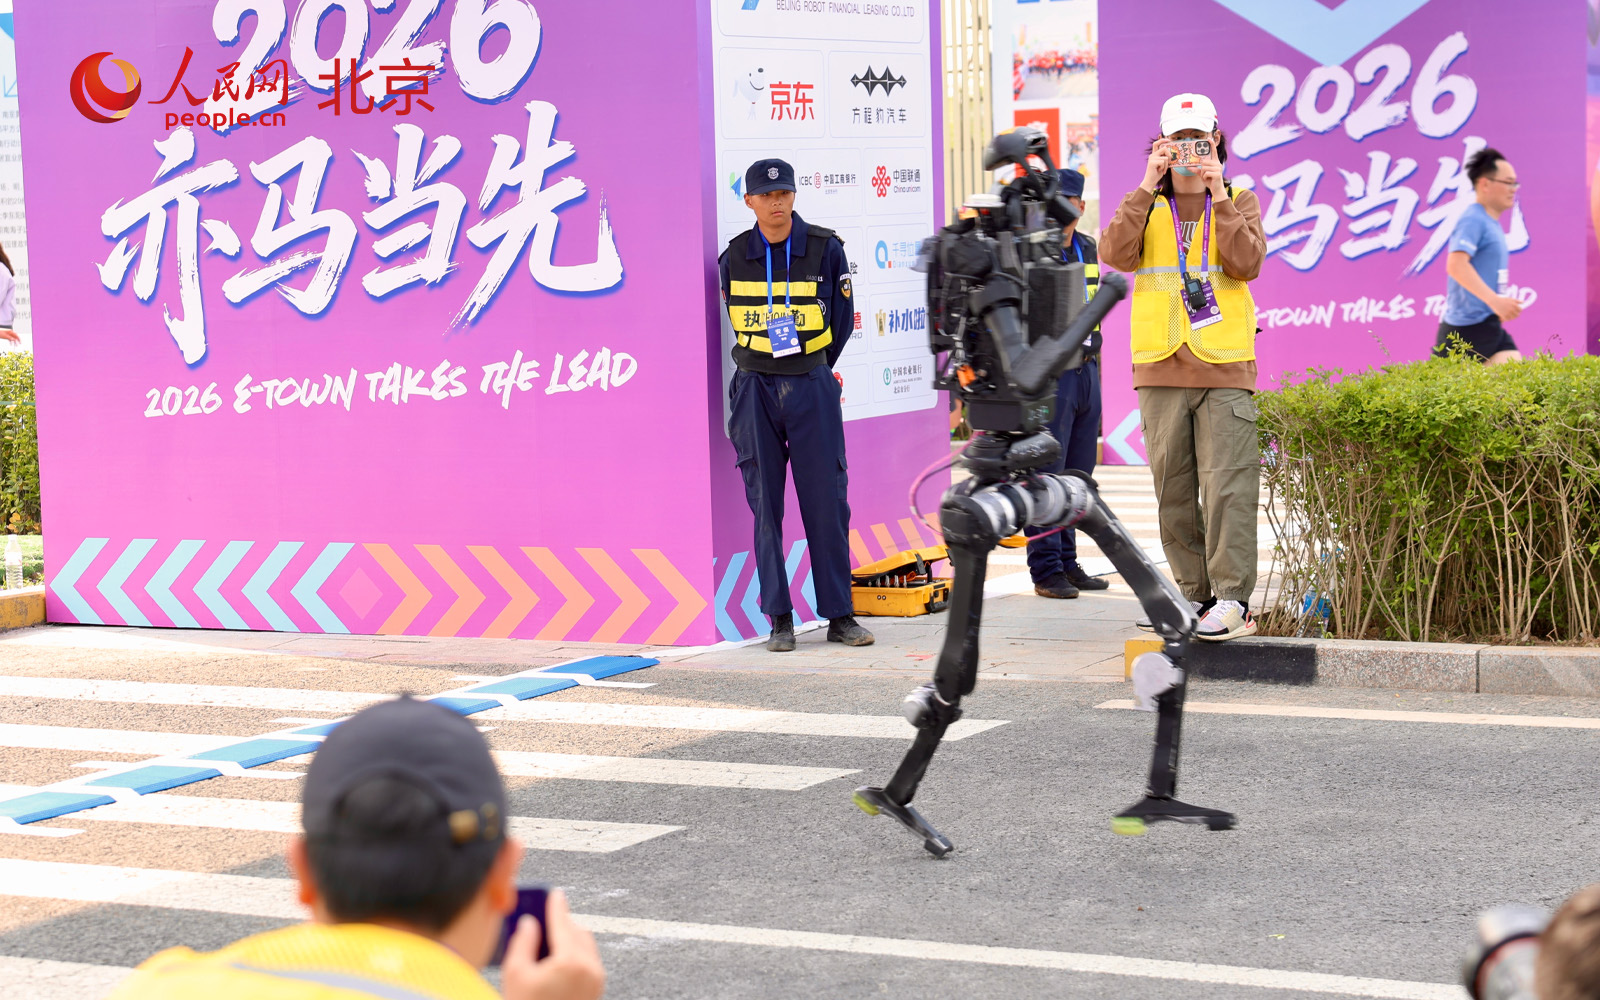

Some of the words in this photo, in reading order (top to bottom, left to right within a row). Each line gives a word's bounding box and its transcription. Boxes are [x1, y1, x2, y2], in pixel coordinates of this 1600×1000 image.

[776, 0, 801, 11] BEIJING
[804, 1, 826, 13] ROBOT
[829, 2, 861, 15] FINANCIAL
[864, 4, 889, 16] LEASING
[205, 0, 542, 131] 2026
[769, 81, 815, 121] 京东
[1231, 31, 1478, 159] 2026
[852, 107, 907, 124] 方程豹汽车
[798, 176, 813, 186] ICBC
[892, 169, 921, 183] 中国联通
[97, 100, 623, 365] 亦马当先
[889, 307, 926, 333] 补水啦
[1340, 294, 1416, 324] TAKES
[144, 382, 222, 418] 2026
[233, 373, 358, 414] E-TOWN
[365, 359, 467, 406] TAKES
[479, 349, 541, 410] THE
[545, 346, 638, 395] LEAD
[892, 364, 922, 378] 中国农业银行
